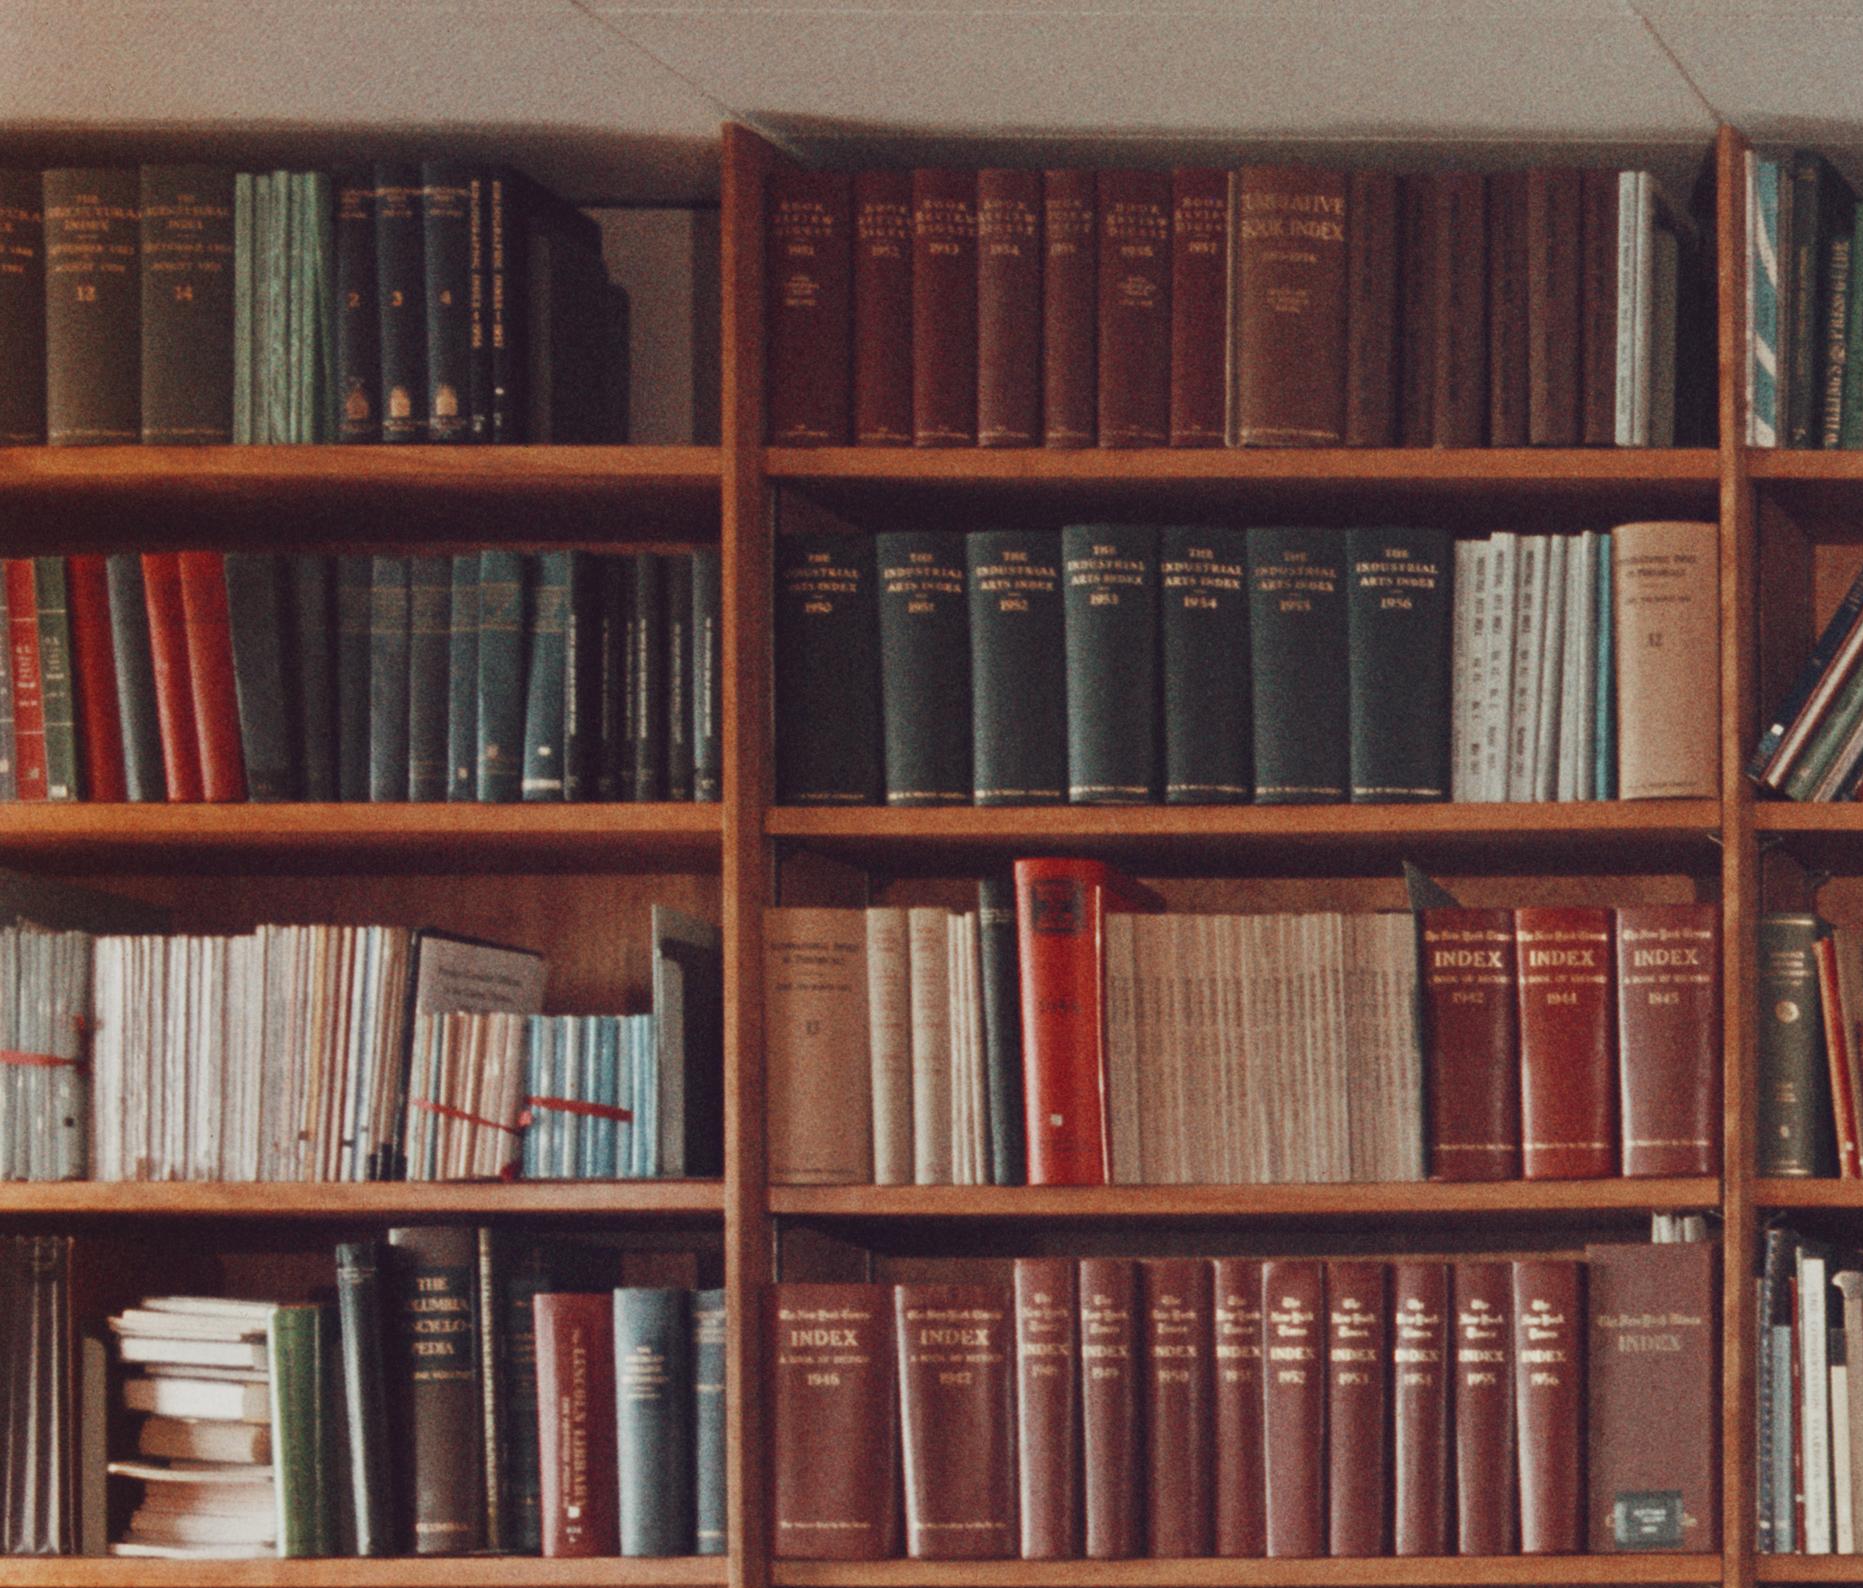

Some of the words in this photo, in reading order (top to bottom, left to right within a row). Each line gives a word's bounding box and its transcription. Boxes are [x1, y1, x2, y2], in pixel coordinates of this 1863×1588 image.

[1433, 950, 1503, 968] INDEX
[1528, 950, 1595, 967] INDEX
[1633, 950, 1700, 967] INDEX
[790, 1330, 859, 1347] INDEX
[919, 1330, 990, 1346] INDEX
[1619, 1334, 1682, 1352] INDEX
